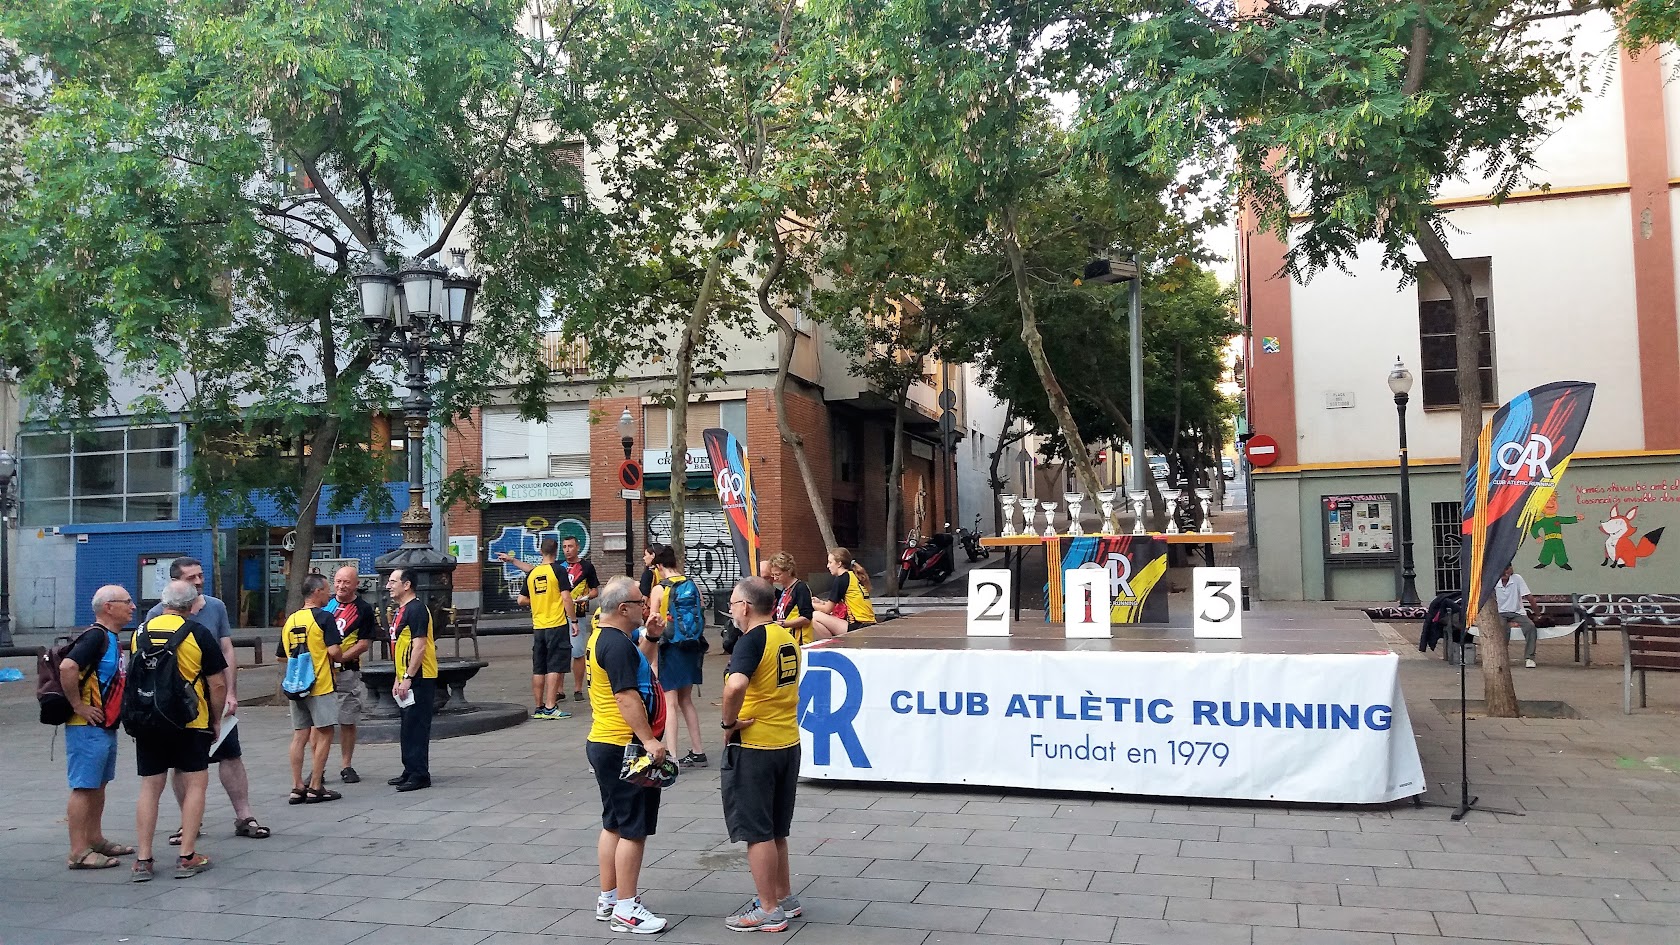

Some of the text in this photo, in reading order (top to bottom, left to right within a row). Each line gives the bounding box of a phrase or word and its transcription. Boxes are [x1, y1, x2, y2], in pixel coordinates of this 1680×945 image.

[974, 582, 1006, 621] 2
[1077, 582, 1099, 624] 1
[1199, 581, 1236, 623] 3
[890, 690, 1393, 731] CLUB ATLÈTIC RUNNING
[1030, 734, 1230, 768] Fundat en 1979
